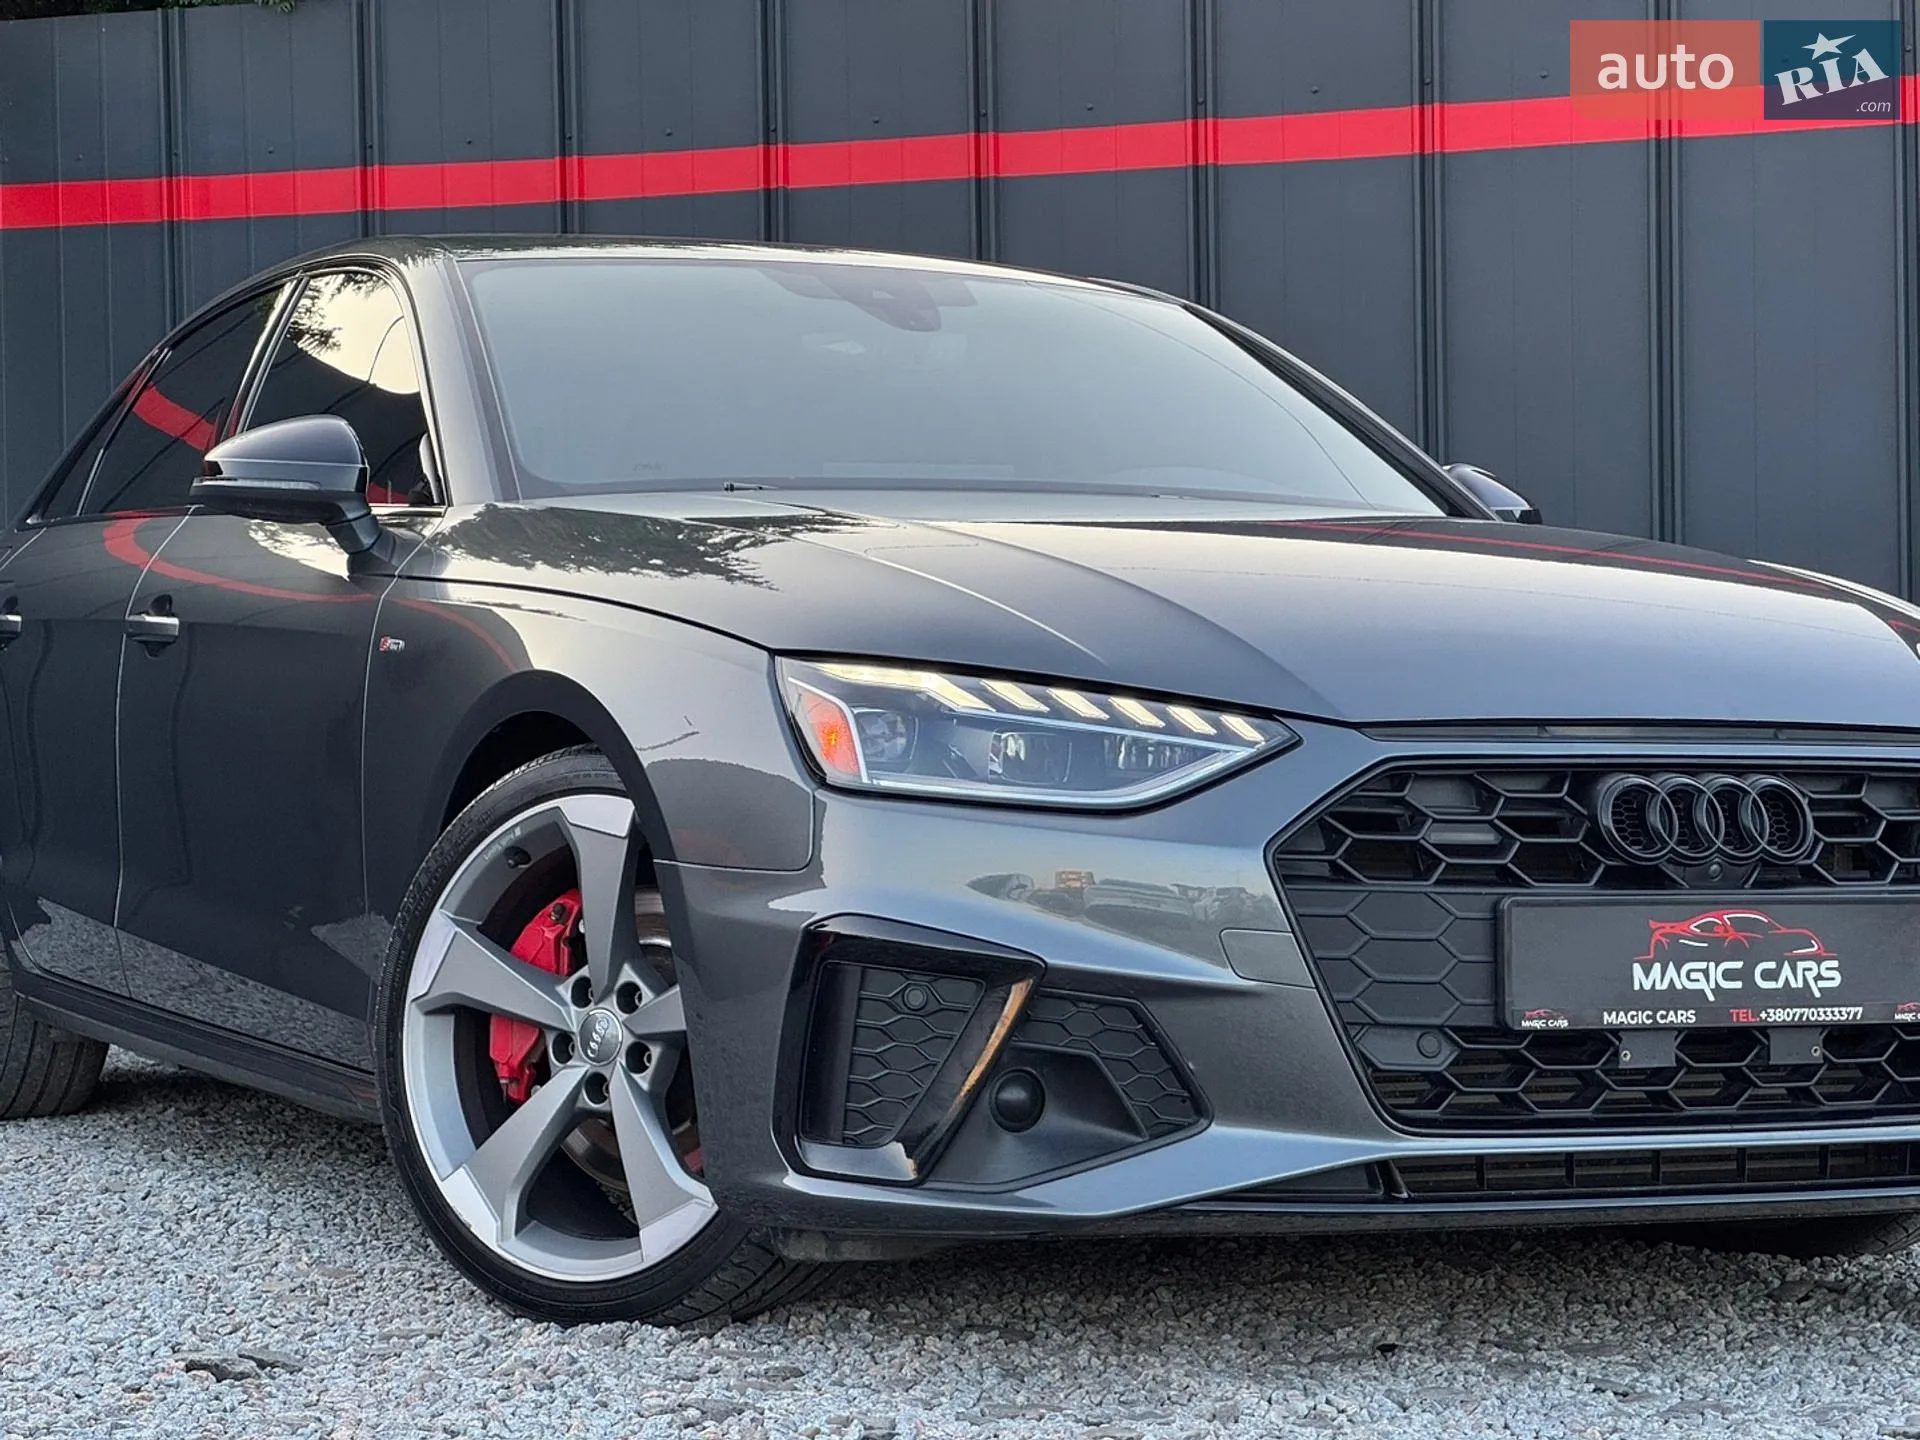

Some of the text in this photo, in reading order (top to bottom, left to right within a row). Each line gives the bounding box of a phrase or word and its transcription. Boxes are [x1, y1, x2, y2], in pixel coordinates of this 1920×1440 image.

[1632, 959, 1842, 1001] MAGIC CARS
[1603, 1009, 1697, 1025] MAGIC CARS
